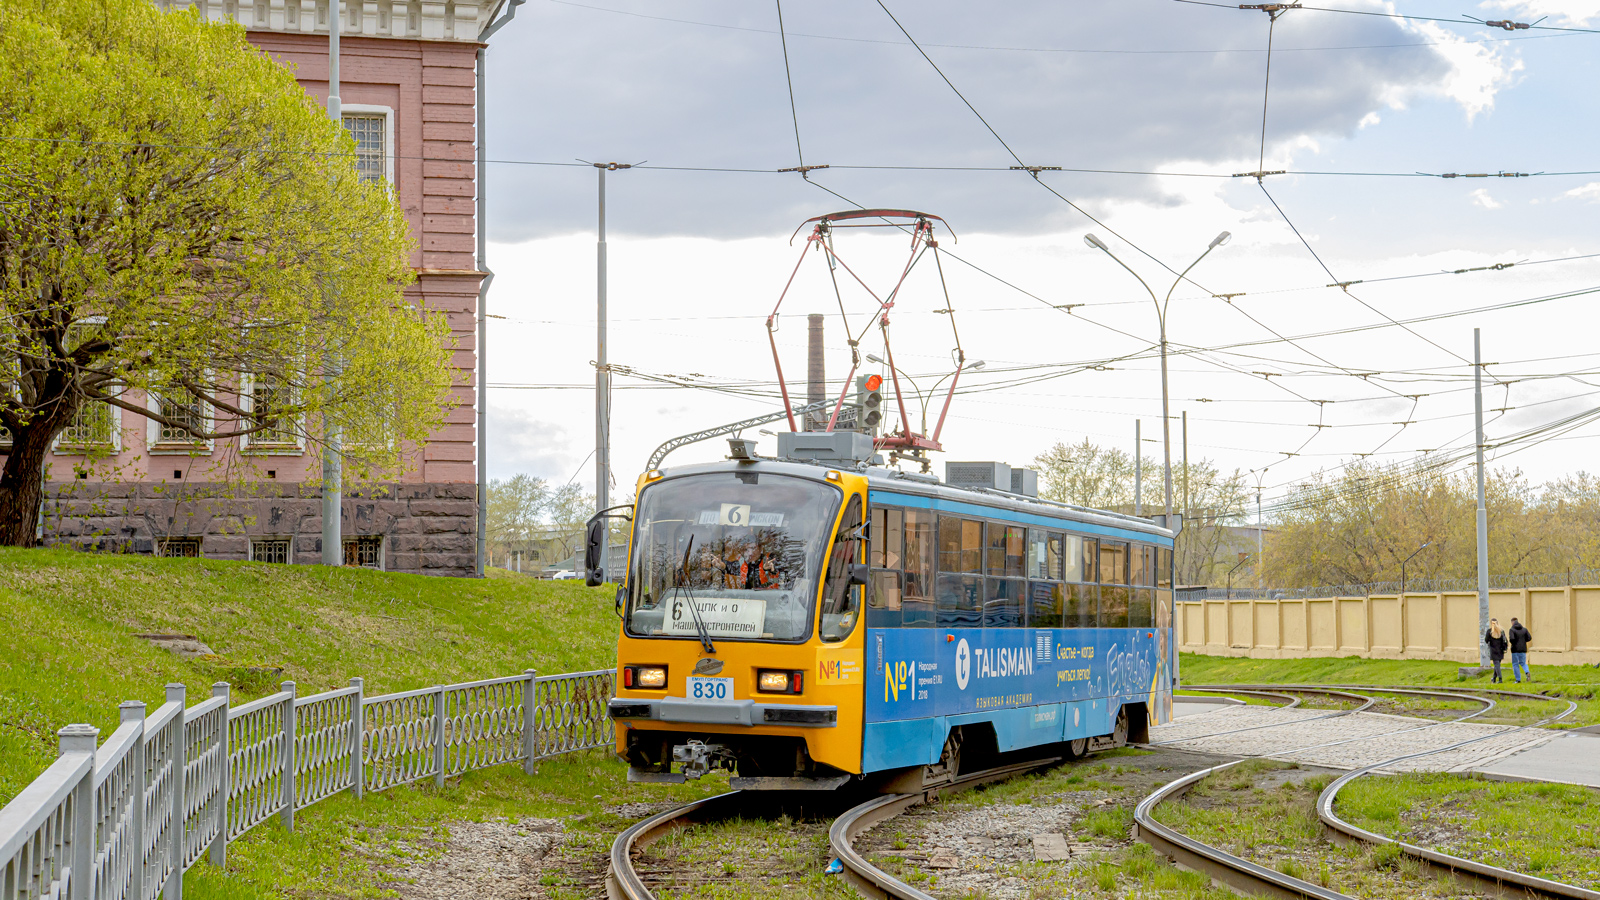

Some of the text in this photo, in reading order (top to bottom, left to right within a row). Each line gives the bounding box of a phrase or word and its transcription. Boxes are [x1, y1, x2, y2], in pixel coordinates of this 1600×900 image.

[727, 505, 742, 524] 6
[671, 601, 684, 621] 6
[1057, 643, 1077, 660] Счастье
[1081, 646, 1095, 660] когда
[819, 659, 841, 680] №1
[974, 647, 1033, 678] TALISMAN
[884, 660, 916, 702] №1
[1057, 664, 1091, 688] учиться легко!
[1106, 636, 1151, 716] English
[693, 682, 727, 699] 830
[976, 692, 1033, 708] ЯЗЫКОВАЯ АКАДЕМИЯ
